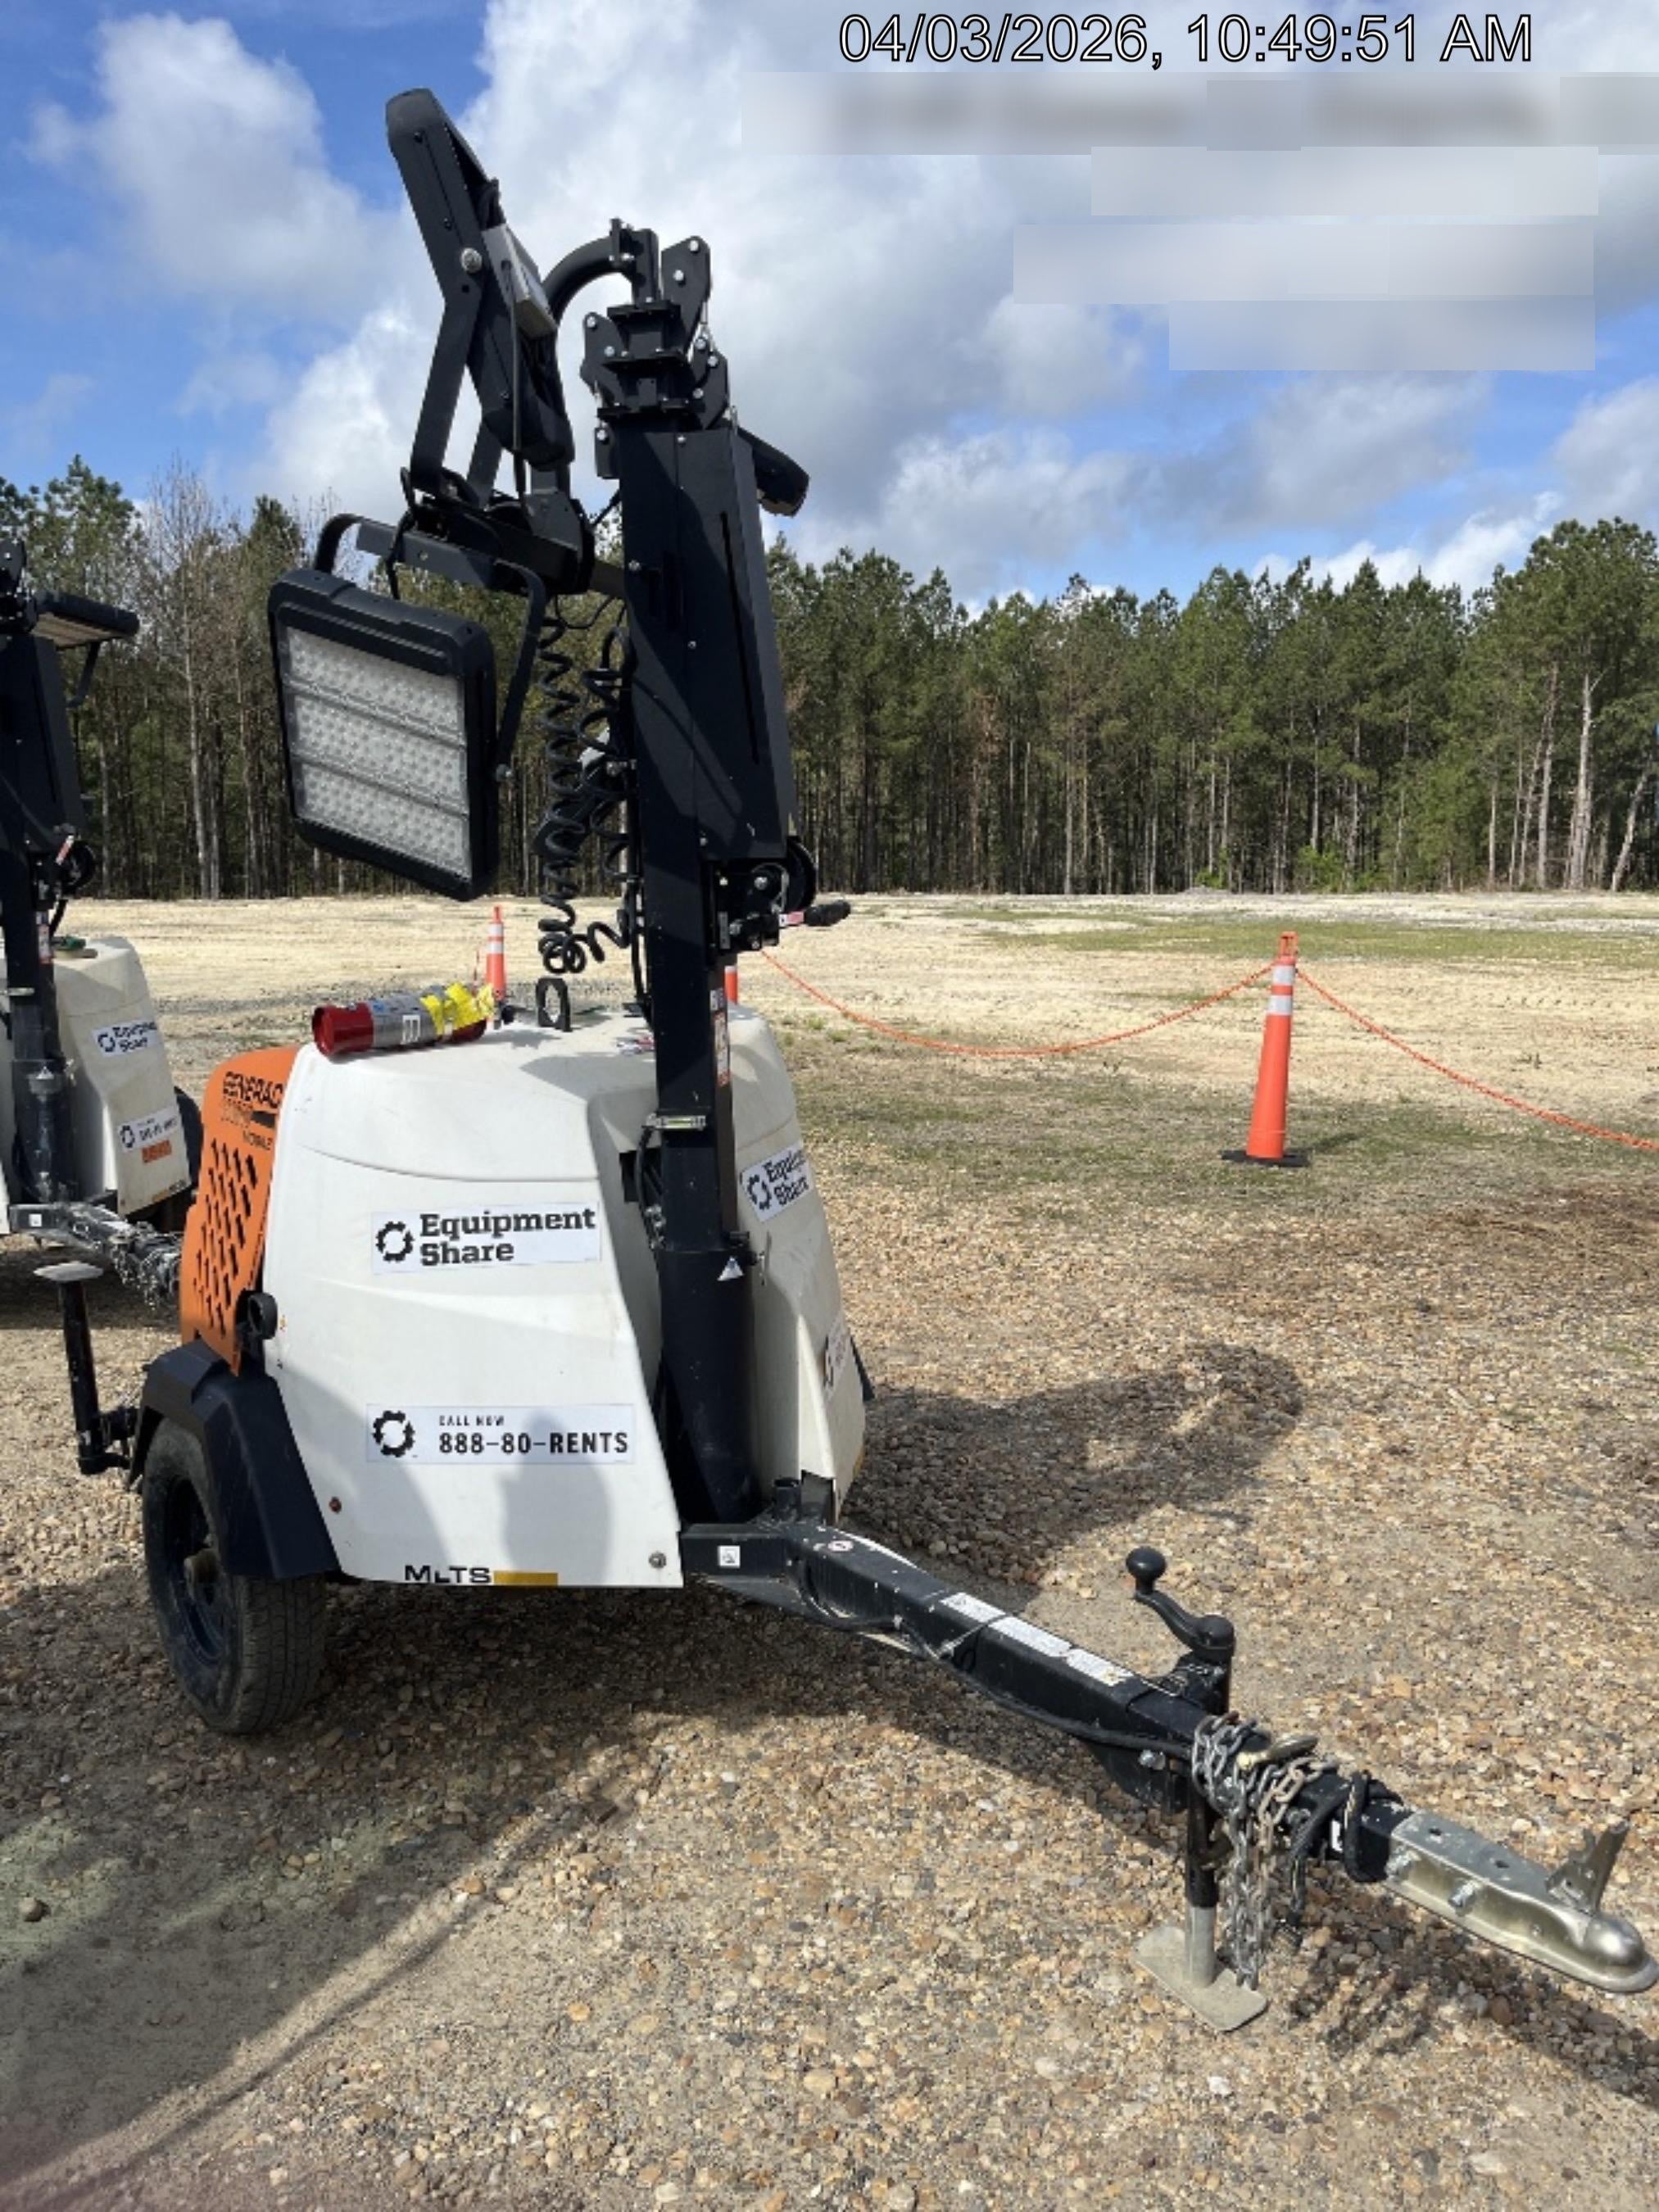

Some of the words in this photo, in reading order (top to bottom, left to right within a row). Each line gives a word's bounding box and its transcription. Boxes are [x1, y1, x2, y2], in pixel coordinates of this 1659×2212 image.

[419, 1208, 596, 1240] Equipment
[419, 1241, 514, 1267] Share
[438, 1415, 470, 1426] CALL
[476, 1415, 505, 1426] NOW
[438, 1432, 628, 1454] 888-80-RENTS
